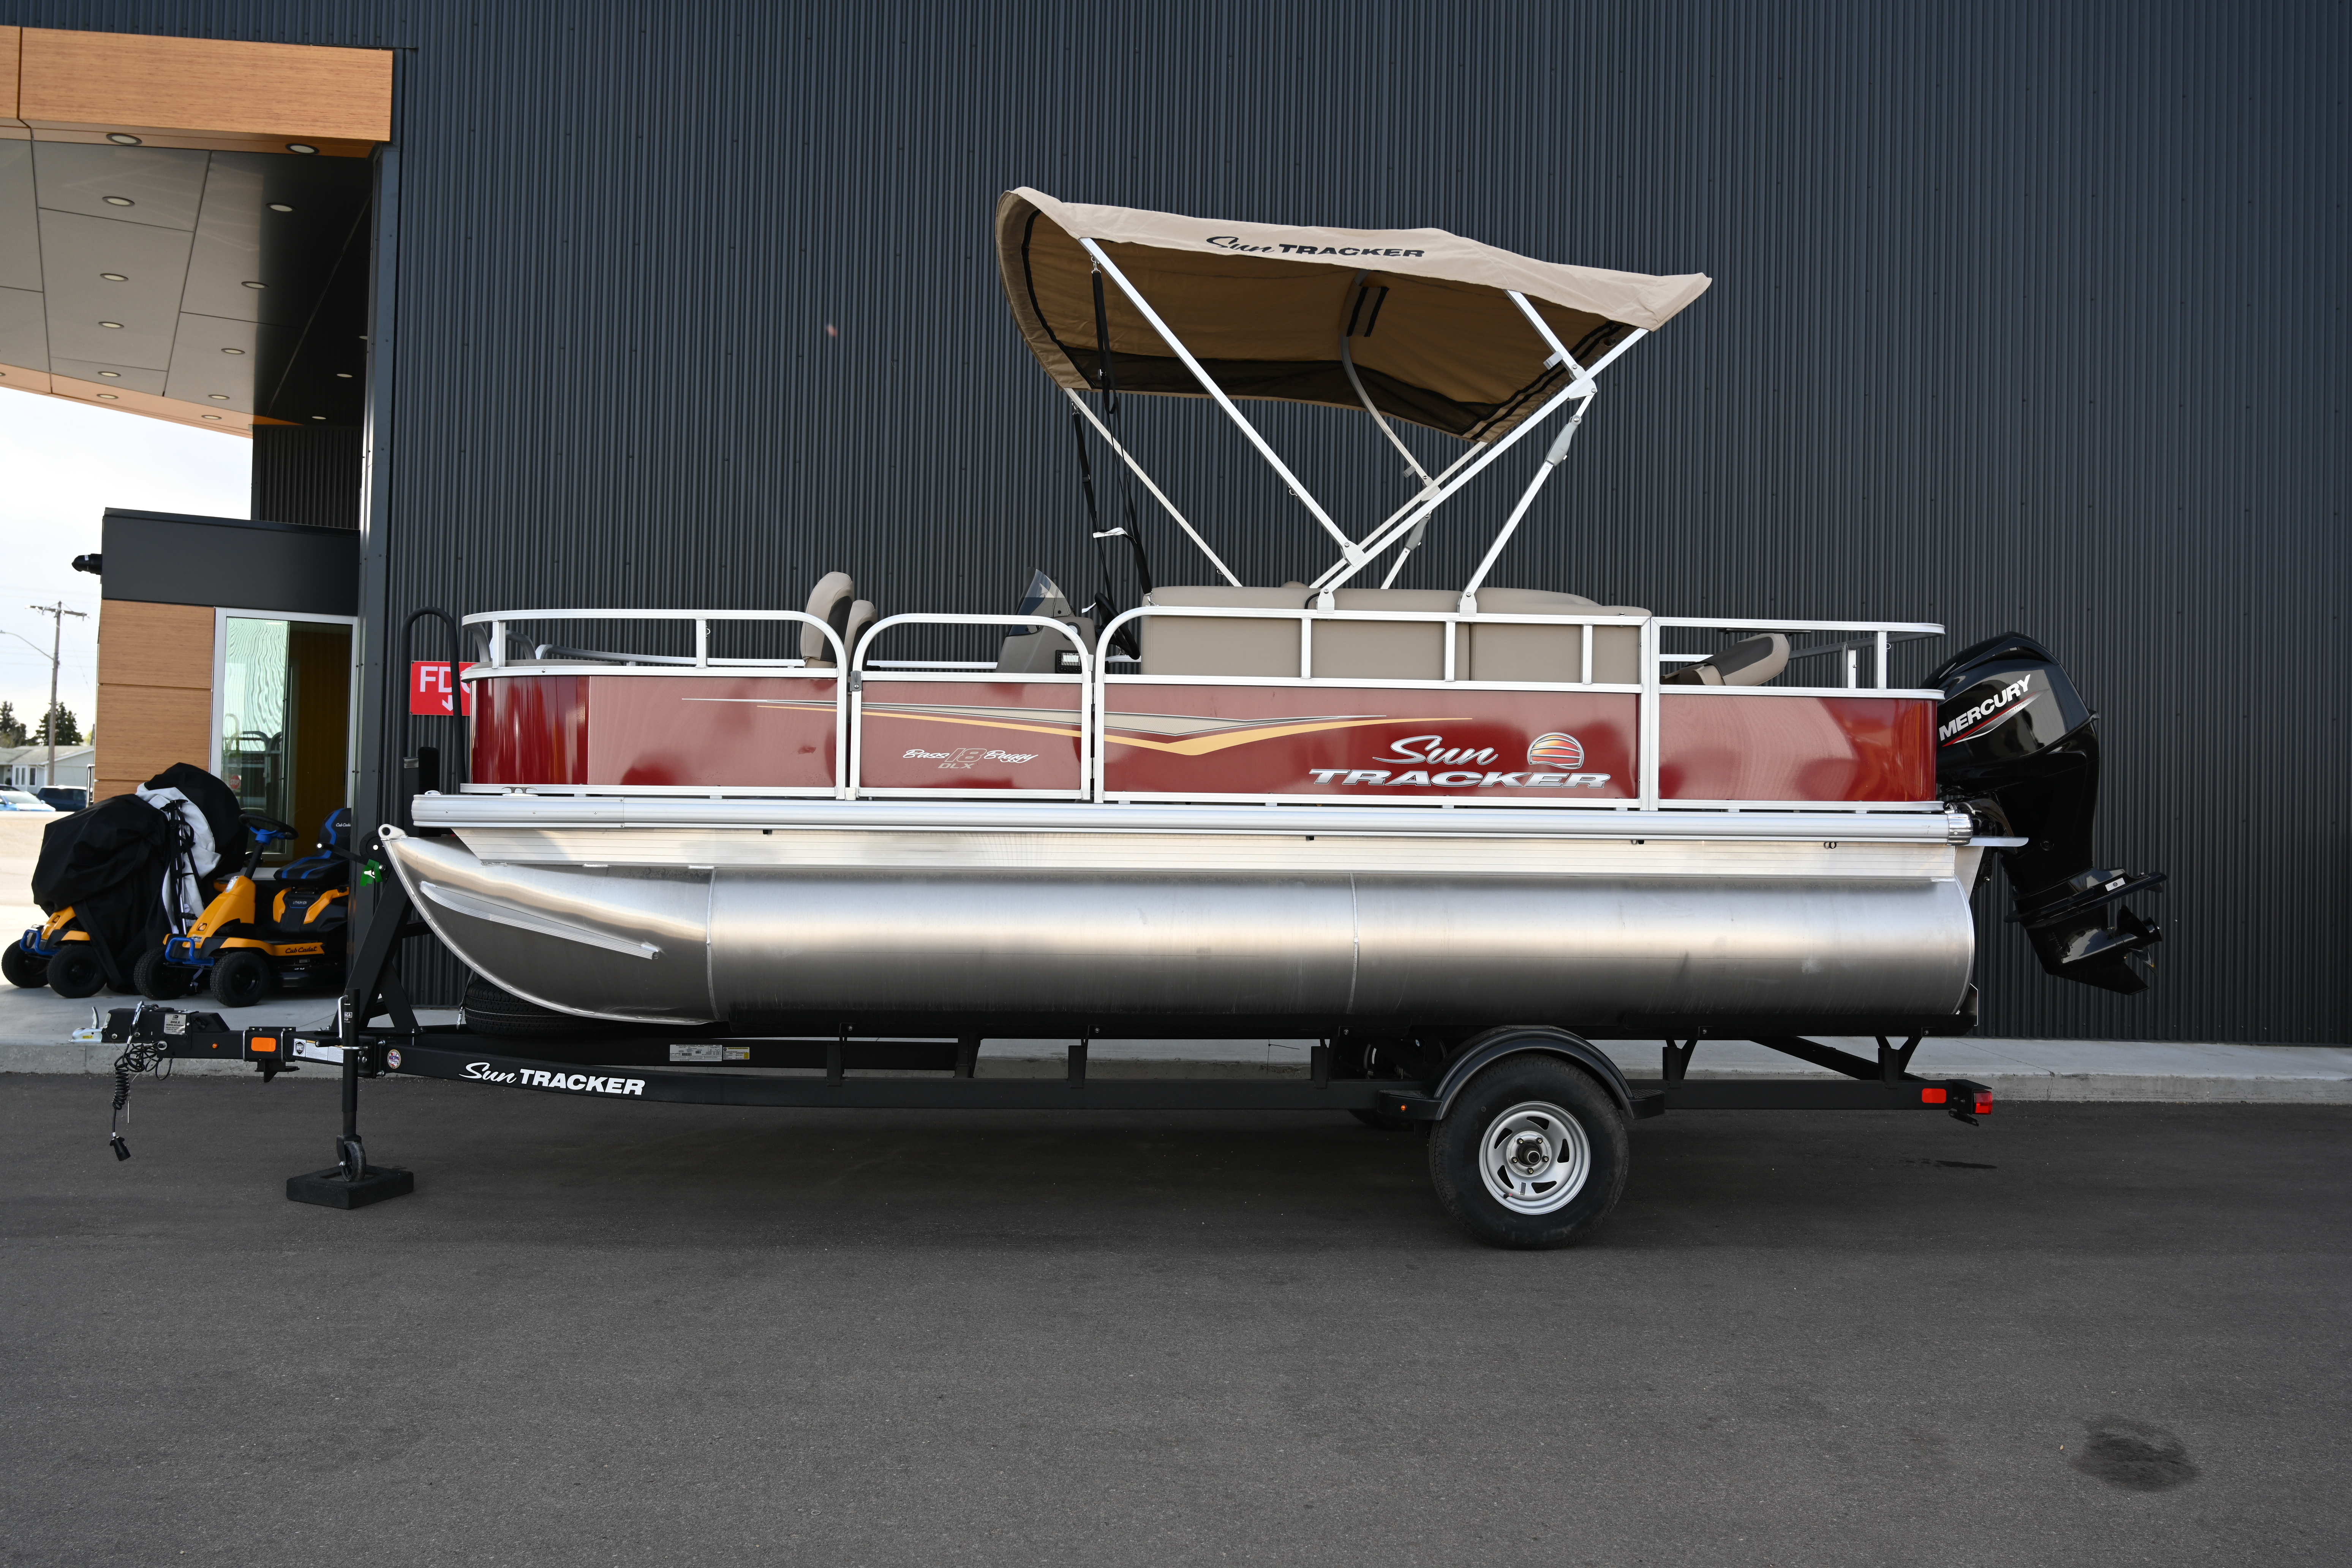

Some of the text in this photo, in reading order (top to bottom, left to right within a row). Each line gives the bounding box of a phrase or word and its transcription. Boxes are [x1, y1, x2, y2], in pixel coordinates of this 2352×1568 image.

[1206, 236, 1425, 257] Sun TRACKER
[1939, 674, 2030, 741] MERCURY
[903, 748, 1038, 763] Bass 18 Buggy
[1372, 735, 1498, 765] Sun
[1309, 769, 1611, 789] TRACKER
[459, 1062, 645, 1095] Sun TRACKER
